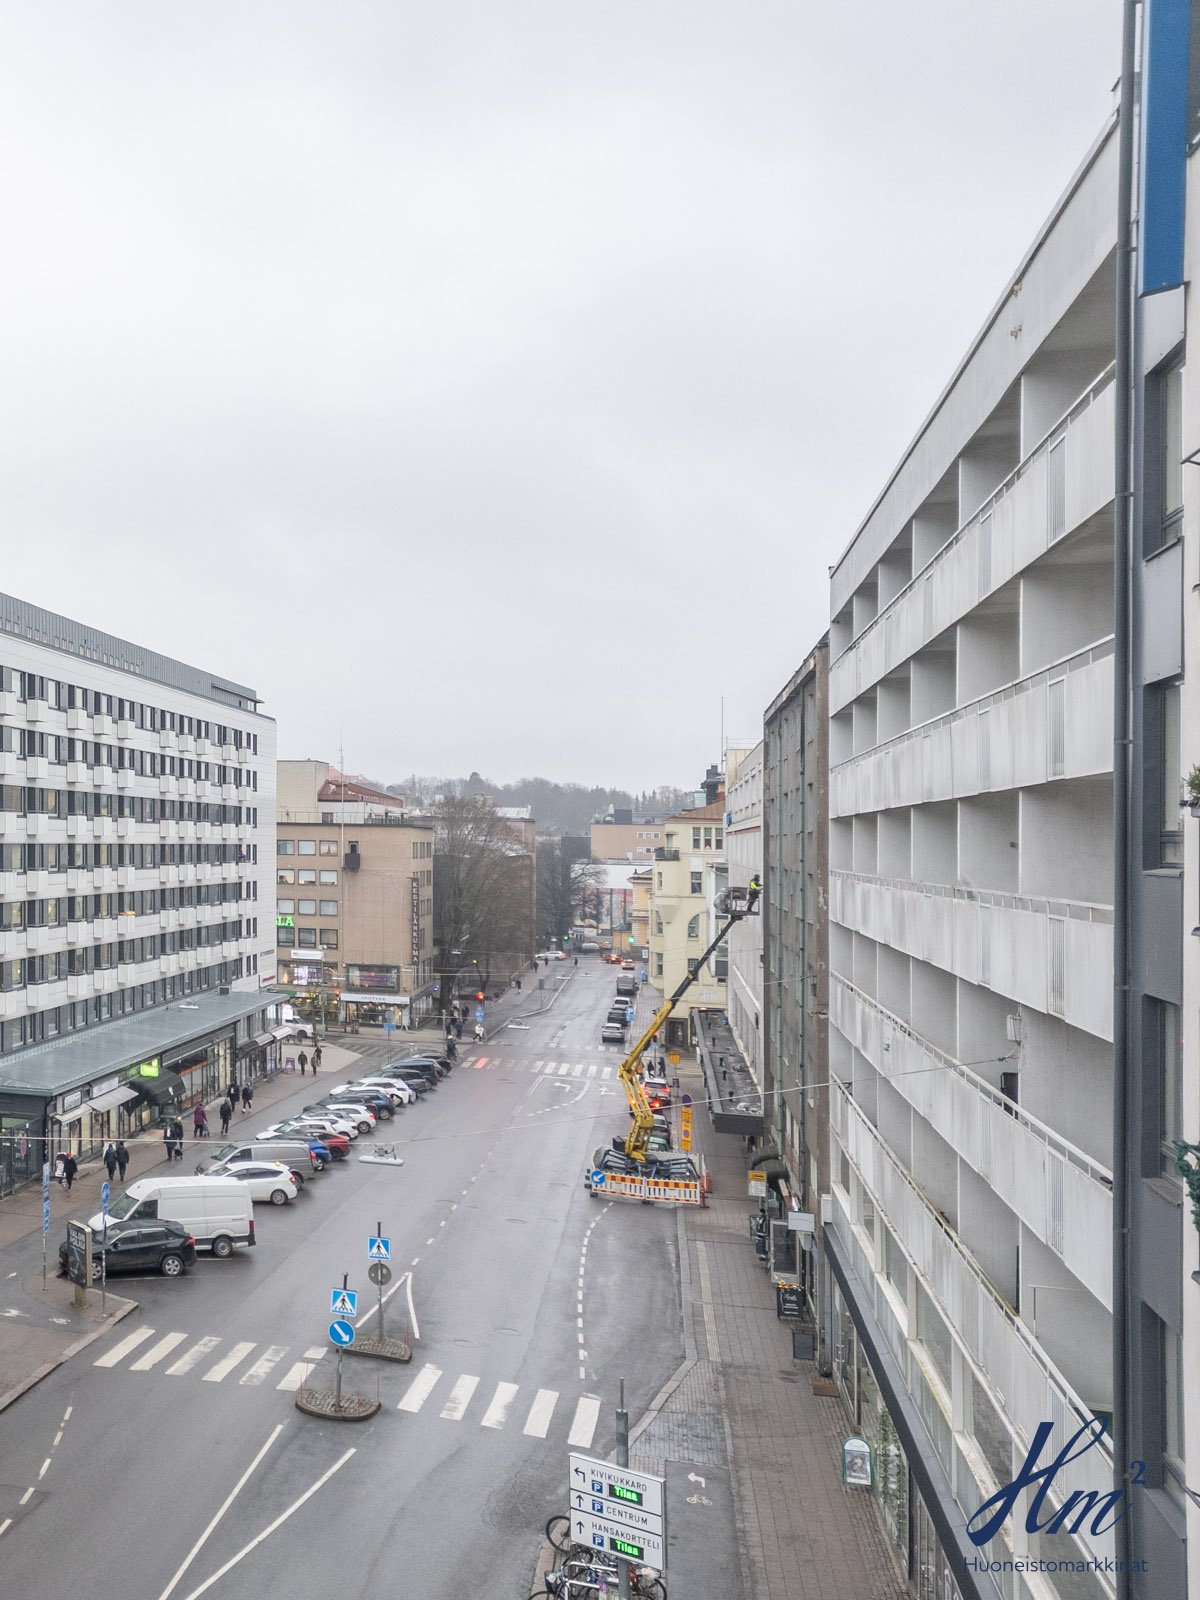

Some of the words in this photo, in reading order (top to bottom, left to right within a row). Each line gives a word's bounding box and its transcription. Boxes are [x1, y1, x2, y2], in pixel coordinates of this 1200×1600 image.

[275, 916, 294, 927] LA
[590, 1469, 647, 1492] KIVIKUKKARO
[614, 1485, 638, 1502] Tilaa
[606, 1506, 648, 1526] CENTRUM
[591, 1521, 660, 1550] HANSAKORTTELI
[615, 1539, 639, 1556] Tilaa
